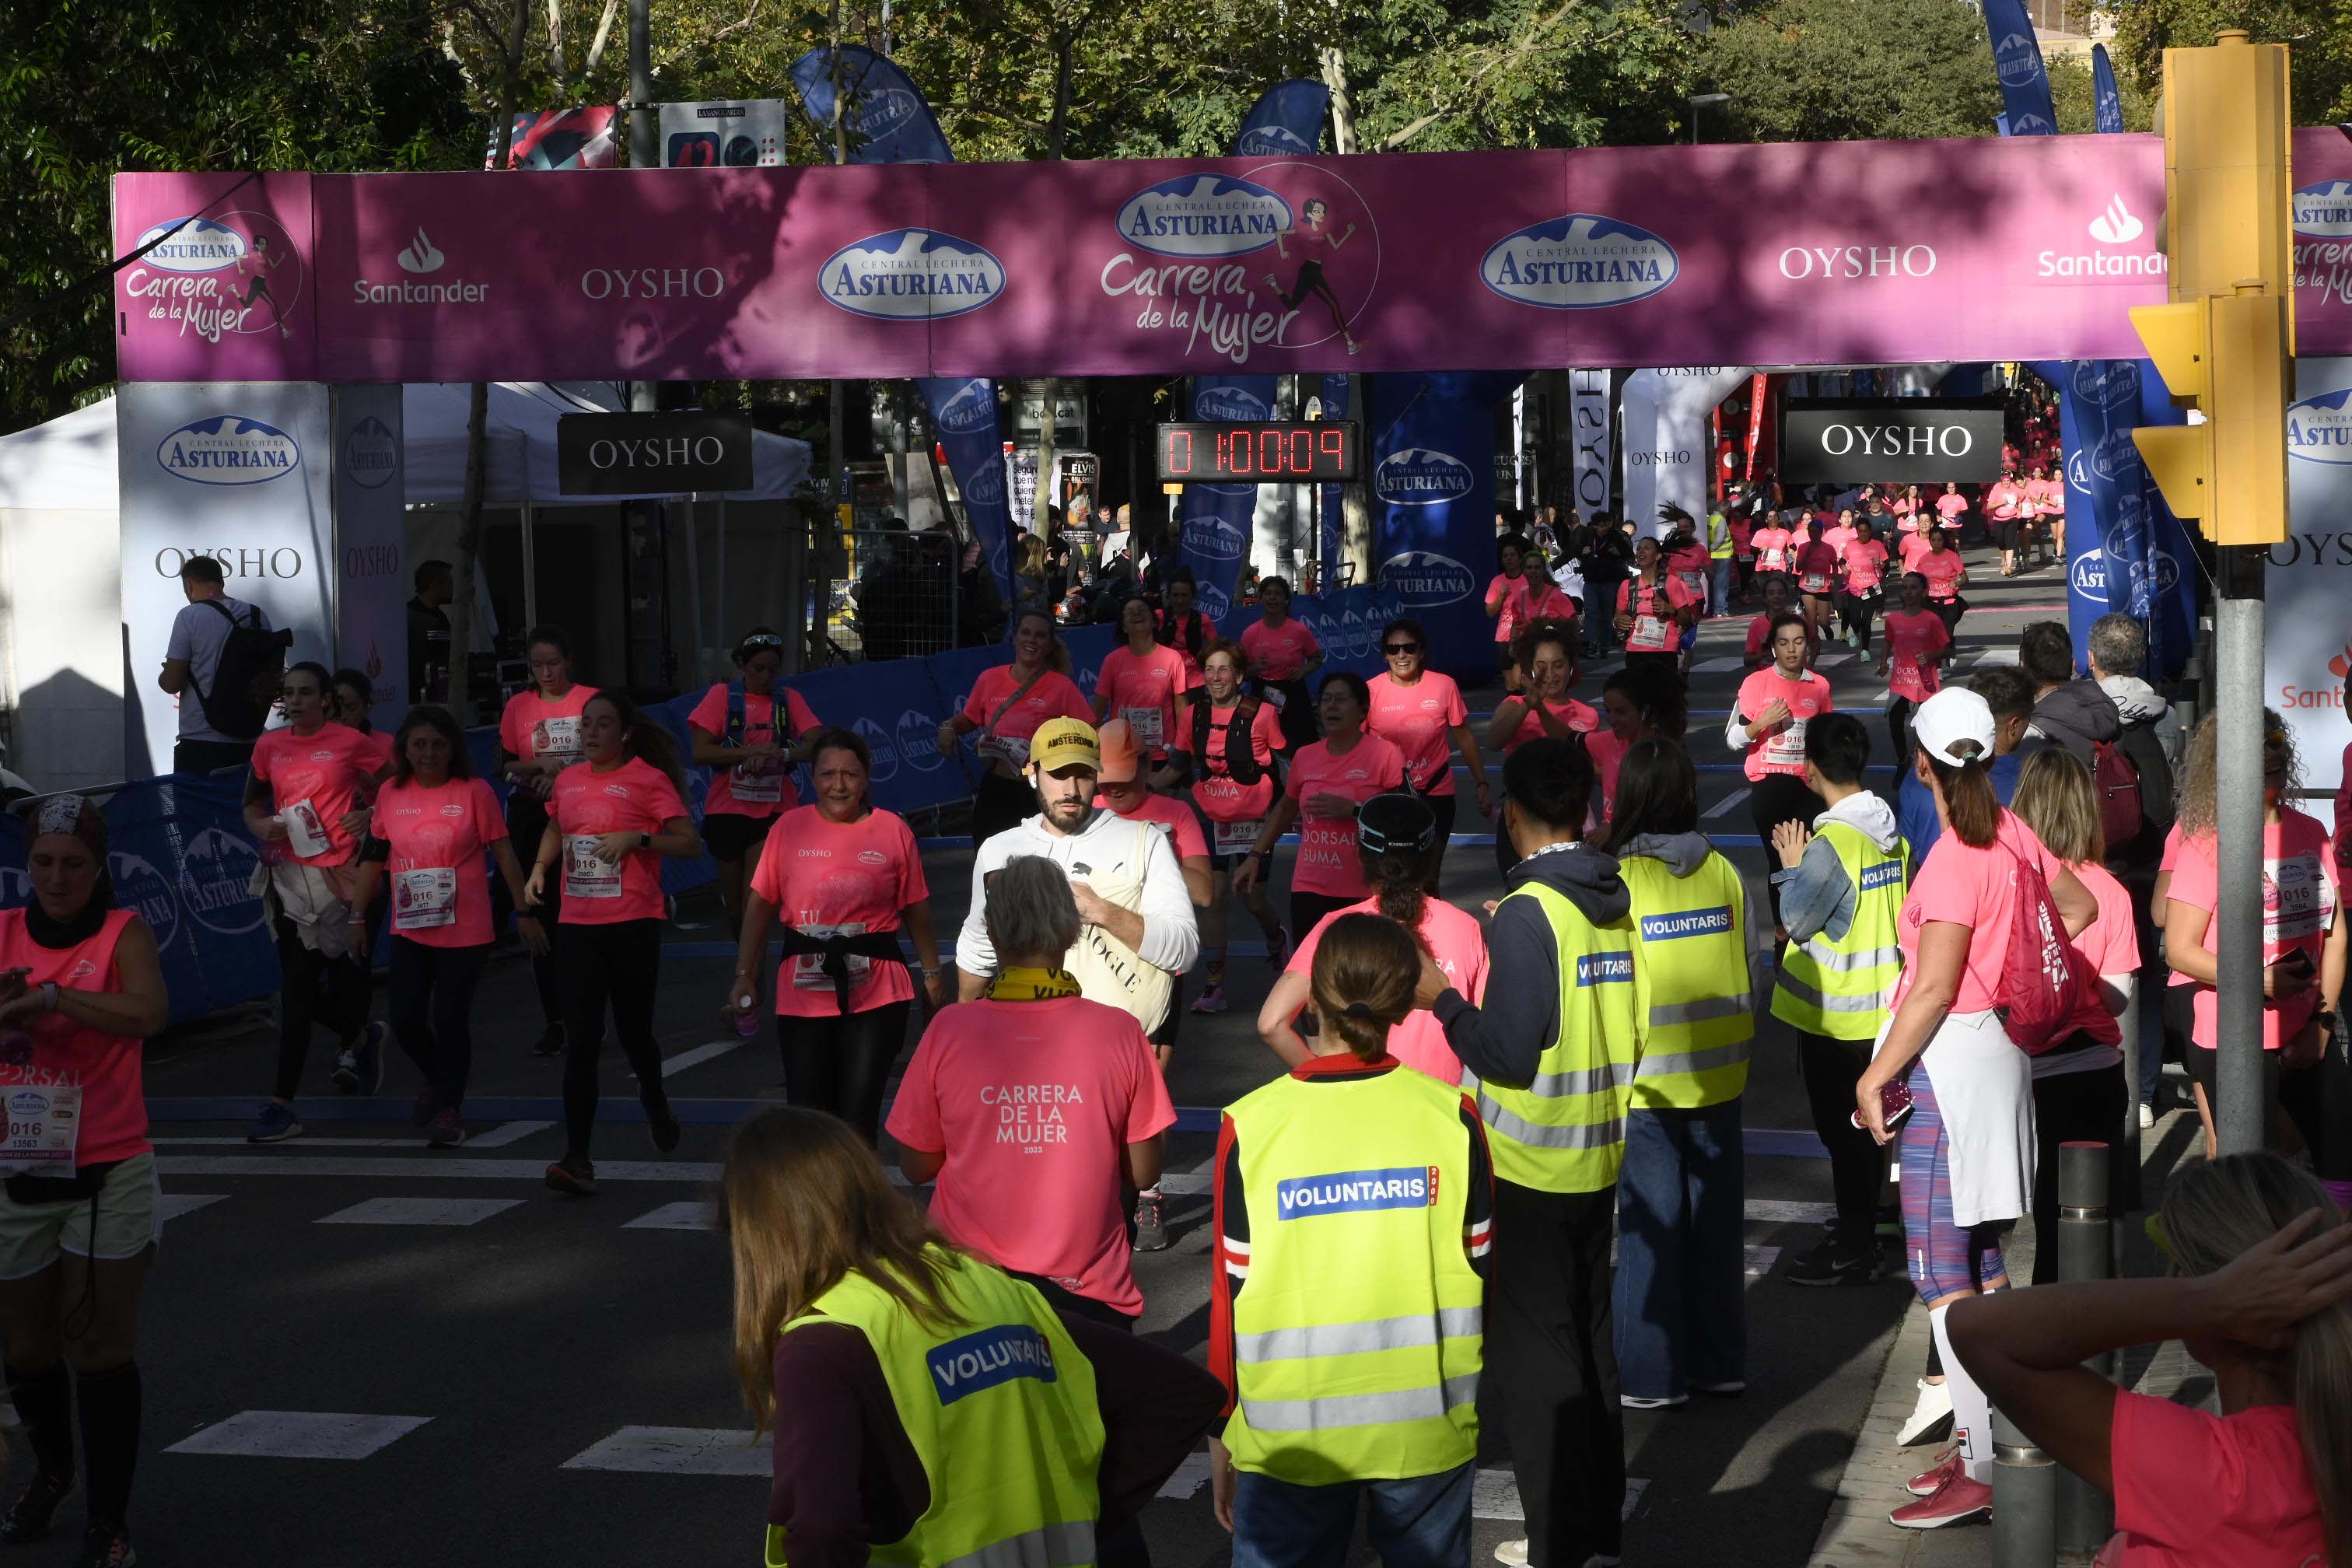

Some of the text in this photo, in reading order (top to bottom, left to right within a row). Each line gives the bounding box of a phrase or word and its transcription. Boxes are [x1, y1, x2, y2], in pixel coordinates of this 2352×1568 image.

[1156, 200, 1274, 212] CENTRAL LECHERA
[1129, 205, 1280, 238] ASTURIANA
[145, 236, 237, 259] ASTURIANA
[1526, 245, 1657, 257] CENTRAL LECHERA
[860, 258, 985, 270] CENTRAL LECHERA
[1496, 250, 1664, 286] ASTURIANA
[1778, 244, 1937, 280] OYSHO
[125, 268, 219, 299] Carrera
[581, 267, 724, 299] OYSHO
[832, 262, 992, 297] ASTURIANA
[1099, 254, 1246, 298] Carrera
[2310, 270, 2325, 288] la
[354, 278, 490, 303] Santander
[149, 294, 254, 343] de la Mujer
[1136, 292, 1301, 364] de la Mujer
[1657, 367, 1721, 377] OYSHO
[239, 439, 285, 447] LECHERA
[1821, 425, 1972, 457] OYSHO
[167, 441, 289, 467] ASTURIANA
[589, 436, 724, 469] OYSHO
[1631, 450, 1691, 466] OYSHO
[1071, 464, 1095, 474] ELVIS
[1013, 474, 1027, 487] que
[1379, 471, 1467, 492] ASTURIANA
[1015, 507, 1028, 516] este
[347, 544, 399, 580] OYSHO
[552, 736, 572, 744] 016
[1048, 735, 1094, 749] AMSTERDAM
[1204, 785, 1238, 797] SUMA
[398, 858, 415, 871] TU
[576, 859, 597, 869] 016
[1302, 847, 1341, 864] SUMA
[414, 891, 433, 901] 016
[2284, 887, 2309, 901] 016
[800, 909, 821, 925] TU
[1642, 913, 1728, 934] VOLUNTARIS
[980, 1084, 1083, 1104] CARRERA
[9, 1101, 46, 1111] ASTURIANA
[1000, 1105, 1063, 1124] DE LA
[10, 1122, 42, 1136] 016
[996, 1125, 1068, 1144] MUJER
[12, 1139, 37, 1148] 13563
[1280, 1178, 1425, 1209] VOLUNTARIS
